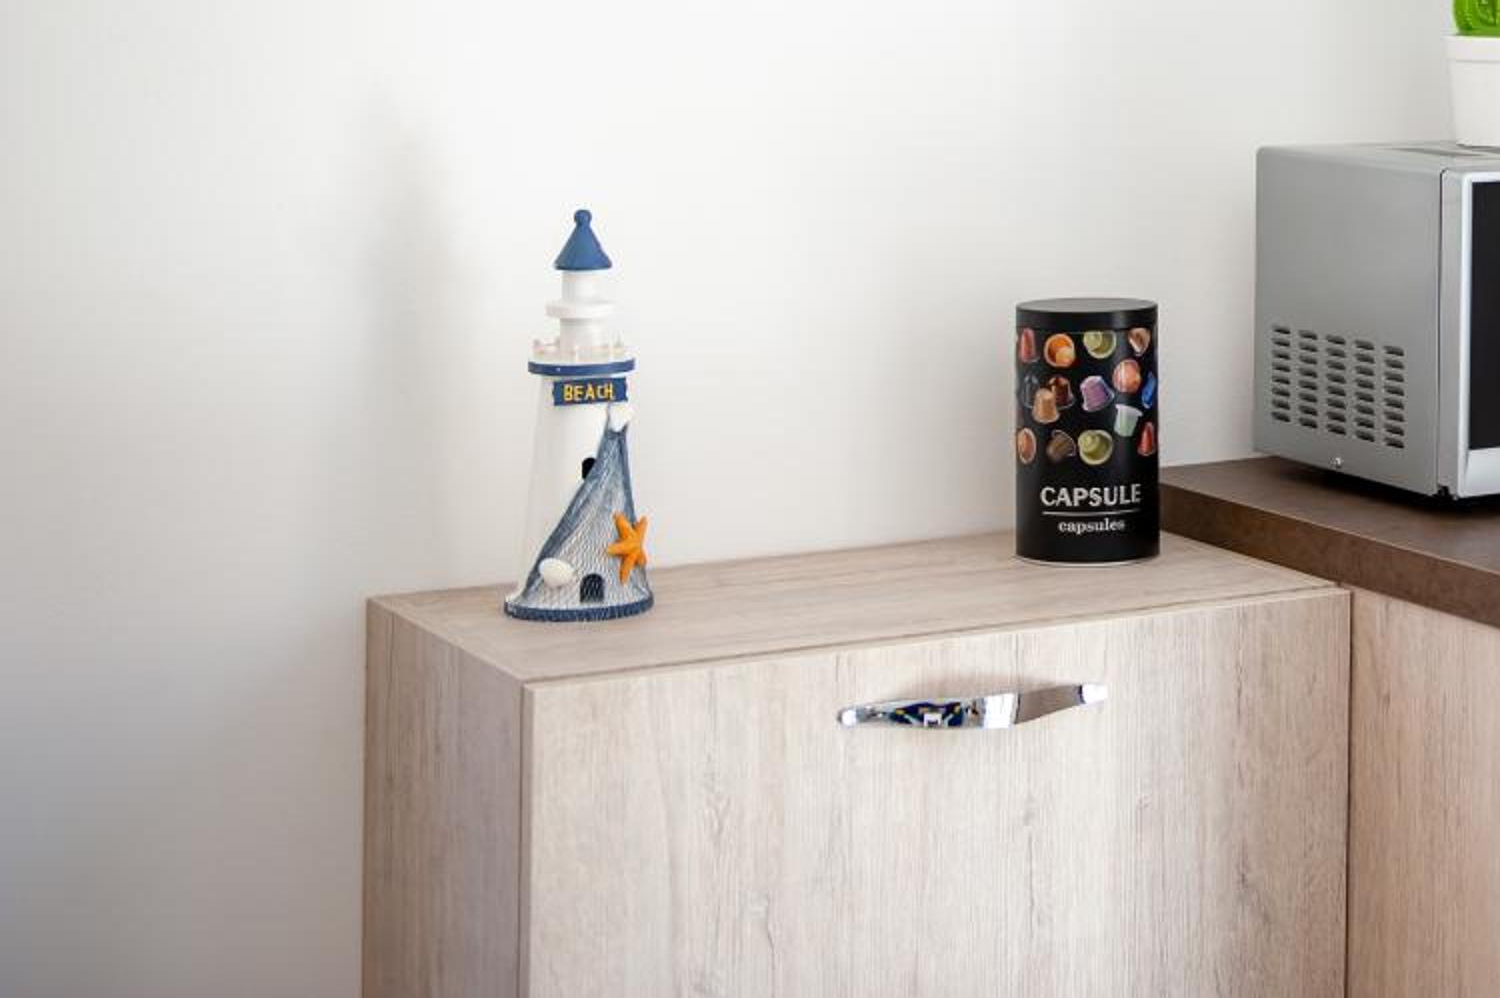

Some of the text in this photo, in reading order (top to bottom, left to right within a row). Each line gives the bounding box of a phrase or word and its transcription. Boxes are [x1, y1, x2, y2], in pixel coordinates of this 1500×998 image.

[563, 381, 614, 402] BEACH
[1040, 483, 1142, 508] CAPSULE
[1057, 517, 1126, 536] capsules
